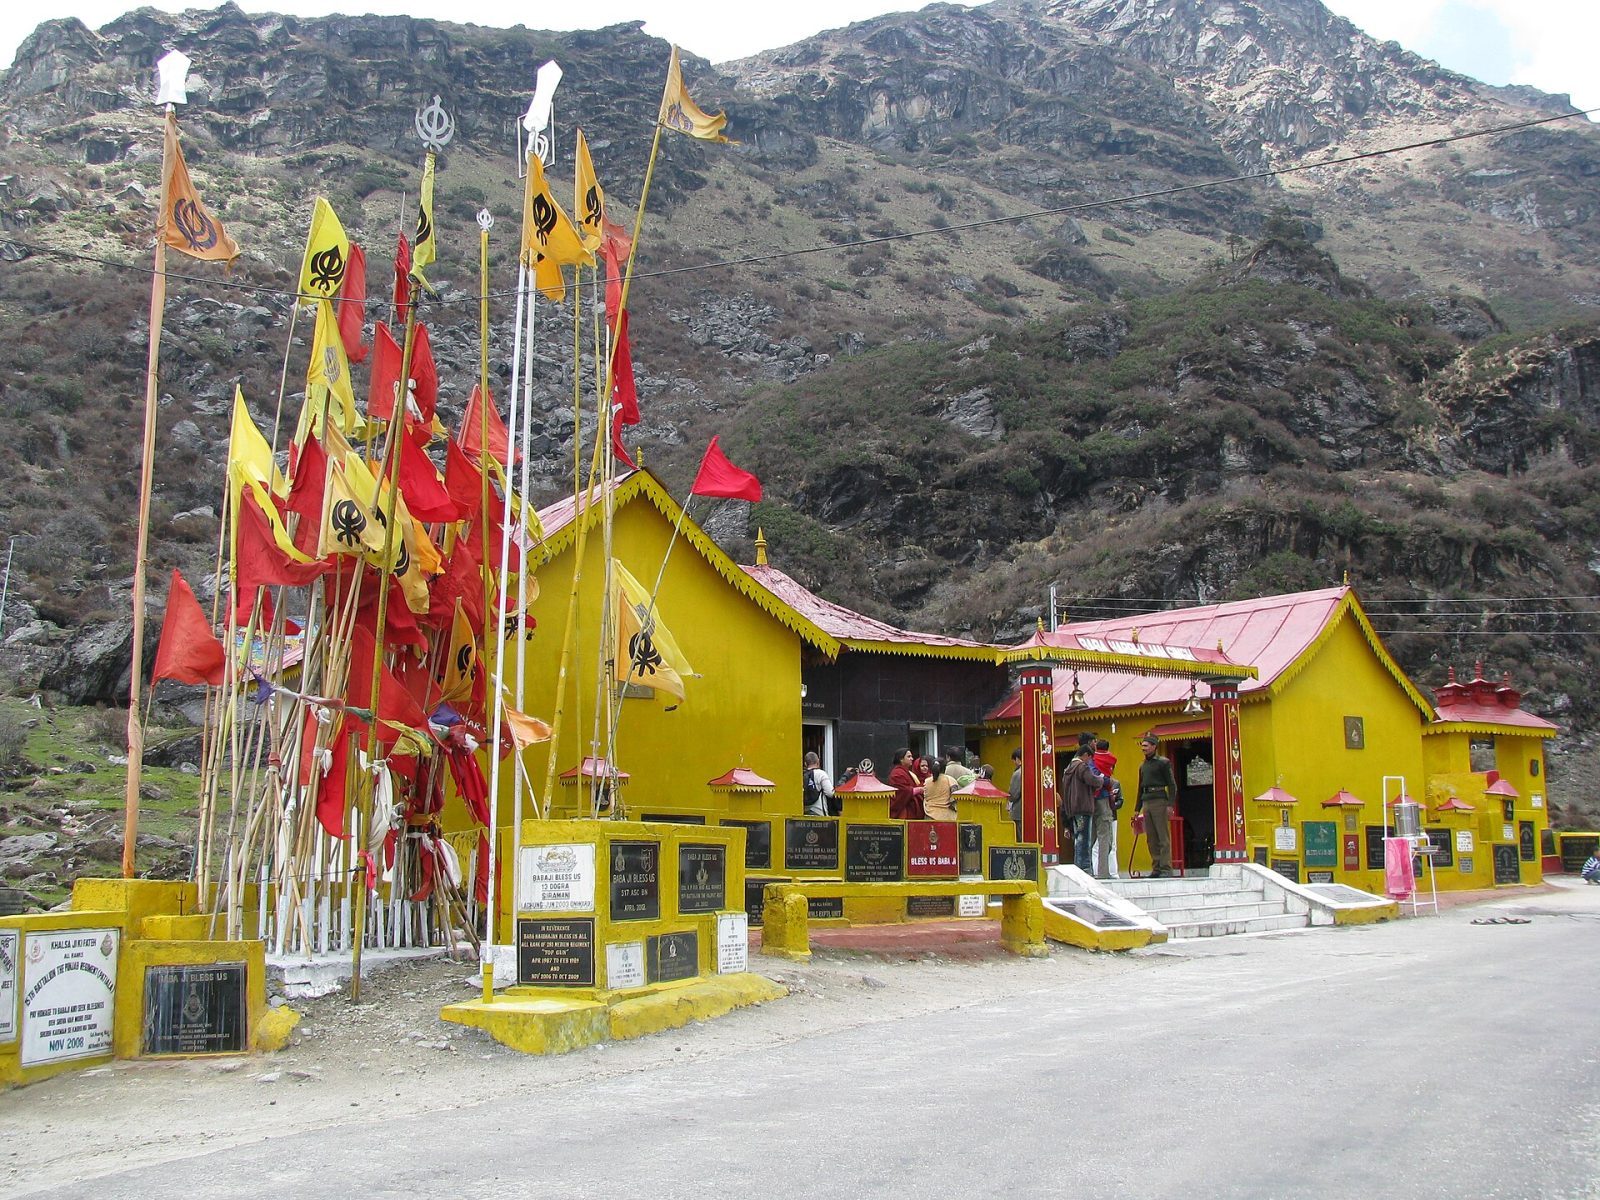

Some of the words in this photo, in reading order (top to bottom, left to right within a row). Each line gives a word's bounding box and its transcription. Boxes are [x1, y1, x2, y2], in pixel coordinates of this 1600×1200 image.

[911, 857, 928, 865] BLESS
[929, 857, 937, 866] US
[937, 857, 951, 865] BABA
[555, 873, 572, 881] BLESS
[612, 874, 626, 883] BABA
[632, 873, 648, 883] BLESS
[648, 873, 656, 883] US
[51, 939, 71, 950] KHALSA
[33, 968, 57, 994] BATTALION
[190, 973, 214, 982] BLESS
[216, 972, 228, 981] US
[49, 1038, 65, 1052] NOV
[66, 1036, 85, 1050] 2008
